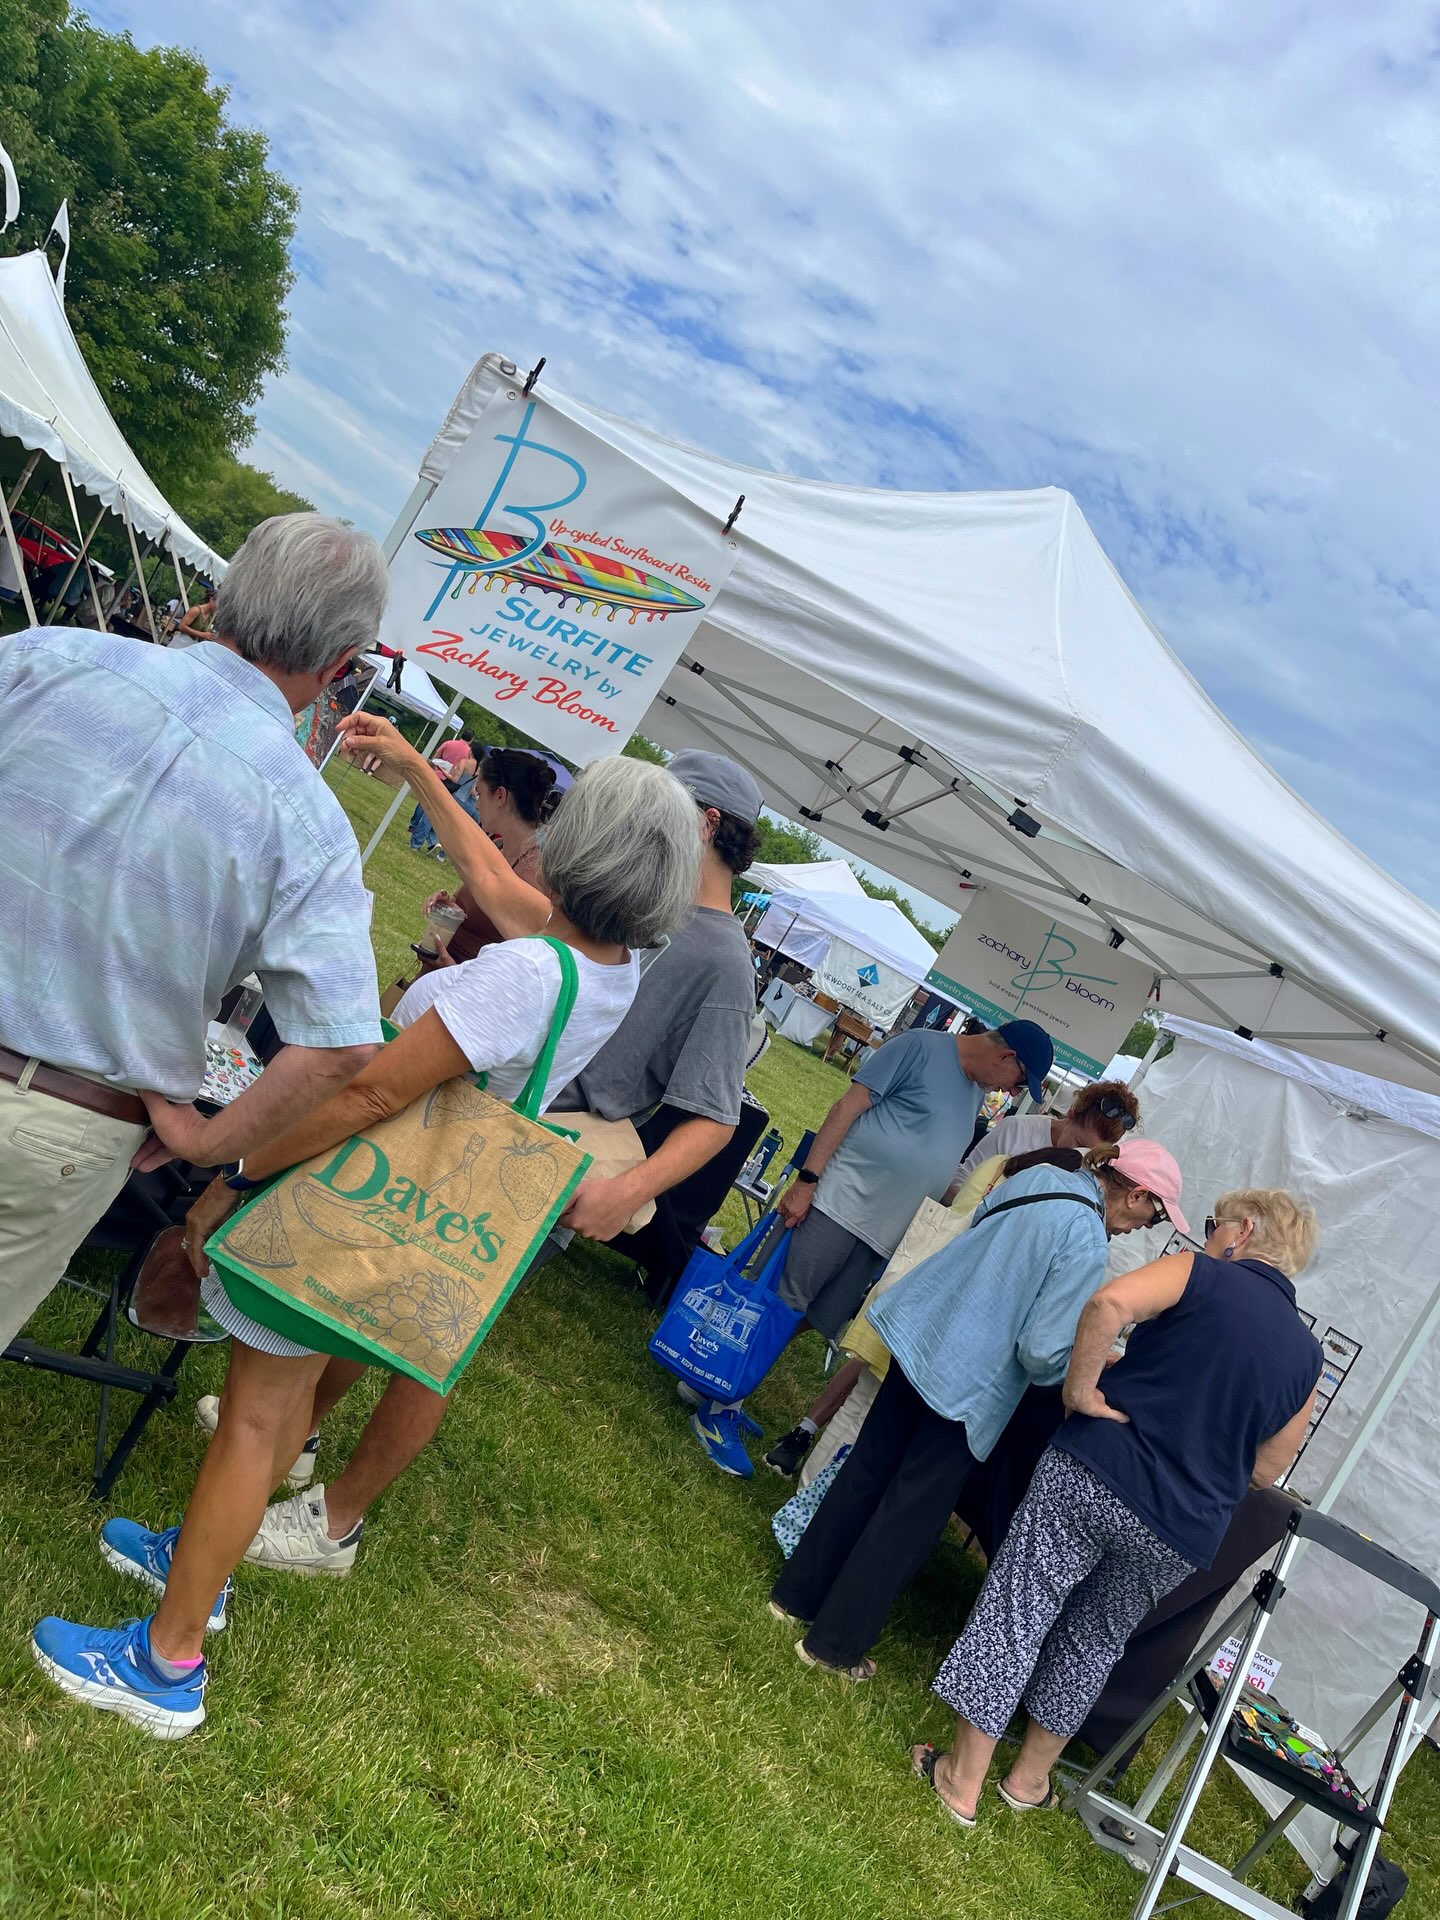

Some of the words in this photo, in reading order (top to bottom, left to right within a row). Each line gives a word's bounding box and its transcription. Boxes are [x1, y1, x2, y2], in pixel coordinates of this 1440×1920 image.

[548, 517, 612, 548] Up-cycled
[610, 538, 677, 574] Surfboard
[674, 564, 711, 593] Resin
[496, 596, 654, 677] SURFITE
[415, 629, 528, 701] Zachary
[531, 676, 620, 734] Bloom
[469, 623, 600, 681] JEWELRY
[597, 677, 623, 700] by
[977, 932, 1032, 971] zachary
[823, 971, 856, 994] NEWPORT
[855, 990, 867, 1002] SEA
[866, 998, 884, 1012] SALT
[1021, 999, 1049, 1017] gemstone
[1064, 977, 1116, 1012] bloom
[936, 978, 964, 997] jewelry
[962, 993, 994, 1014] designer
[1072, 1055, 1095, 1071] cutter
[309, 1135, 506, 1264] Dave's
[407, 1230, 487, 1281] marketplace
[302, 1275, 339, 1307] RHODE
[338, 1299, 381, 1328] ISLAND
[687, 1326, 720, 1352] Dave's
[1219, 1645, 1238, 1658] GEMS
[1253, 1651, 1275, 1667] OCKS
[1245, 1673, 1266, 1690] ach
